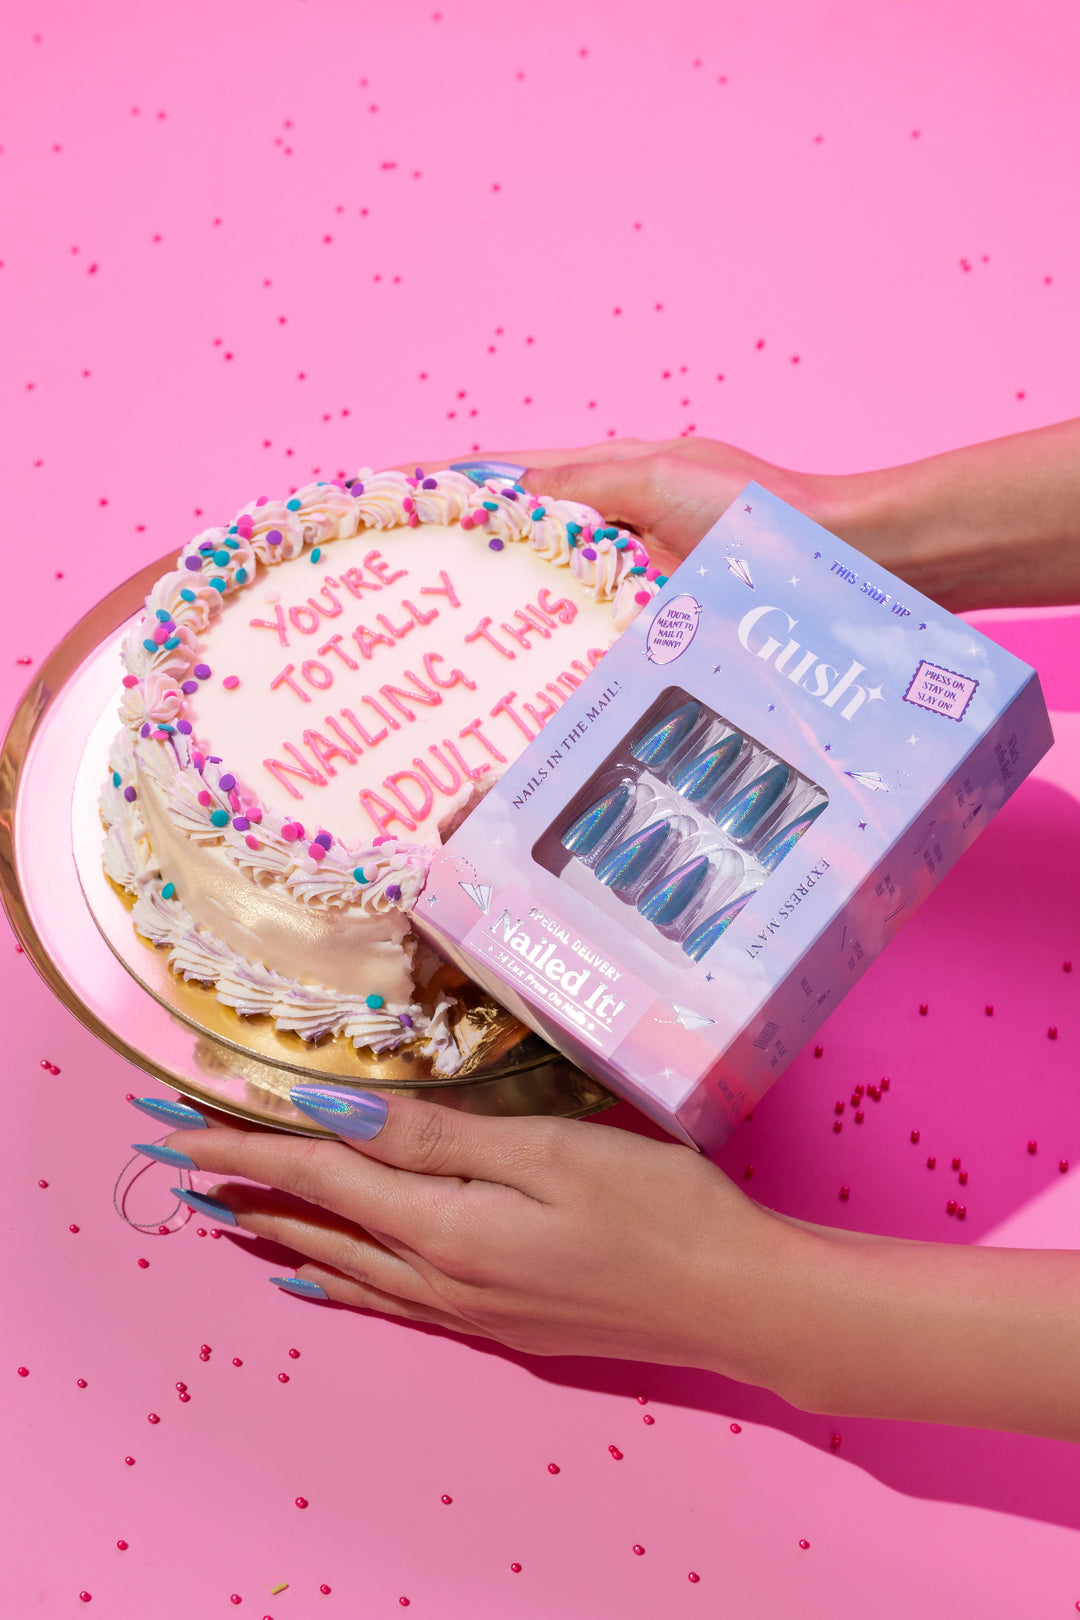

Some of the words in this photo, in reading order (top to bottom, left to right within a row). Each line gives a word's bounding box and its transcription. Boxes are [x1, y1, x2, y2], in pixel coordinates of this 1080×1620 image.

[249, 550, 408, 647] YOU'RE
[667, 608, 692, 621] YOU'RE
[830, 559, 860, 585] THIS
[860, 581, 892, 607] SIDE
[892, 601, 912, 618] UP
[270, 570, 461, 703] TOTALLY
[656, 617, 684, 629] MEANT
[682, 622, 694, 632] TO
[657, 629, 675, 638] NAIL
[262, 651, 477, 800] NAILING
[464, 588, 578, 660] THIS
[737, 605, 868, 722] Gush
[923, 681, 945, 695] STAY
[924, 669, 952, 687] PRESS
[917, 691, 938, 705] SLAY
[937, 699, 953, 711] ON!
[512, 768, 548, 810] NAILS
[546, 749, 563, 770] IN
[560, 721, 589, 751] THE
[586, 680, 623, 723] MAIL!
[358, 718, 507, 838] ADULT
[778, 857, 831, 920] EXPRESS
[489, 908, 591, 997] Nailed
[583, 981, 628, 1018] It!
[528, 907, 571, 945] SPECIAL
[571, 940, 624, 982] DELIVERY
[506, 958, 526, 978] Lux
[524, 973, 549, 996] Press
[547, 992, 563, 1007] On
